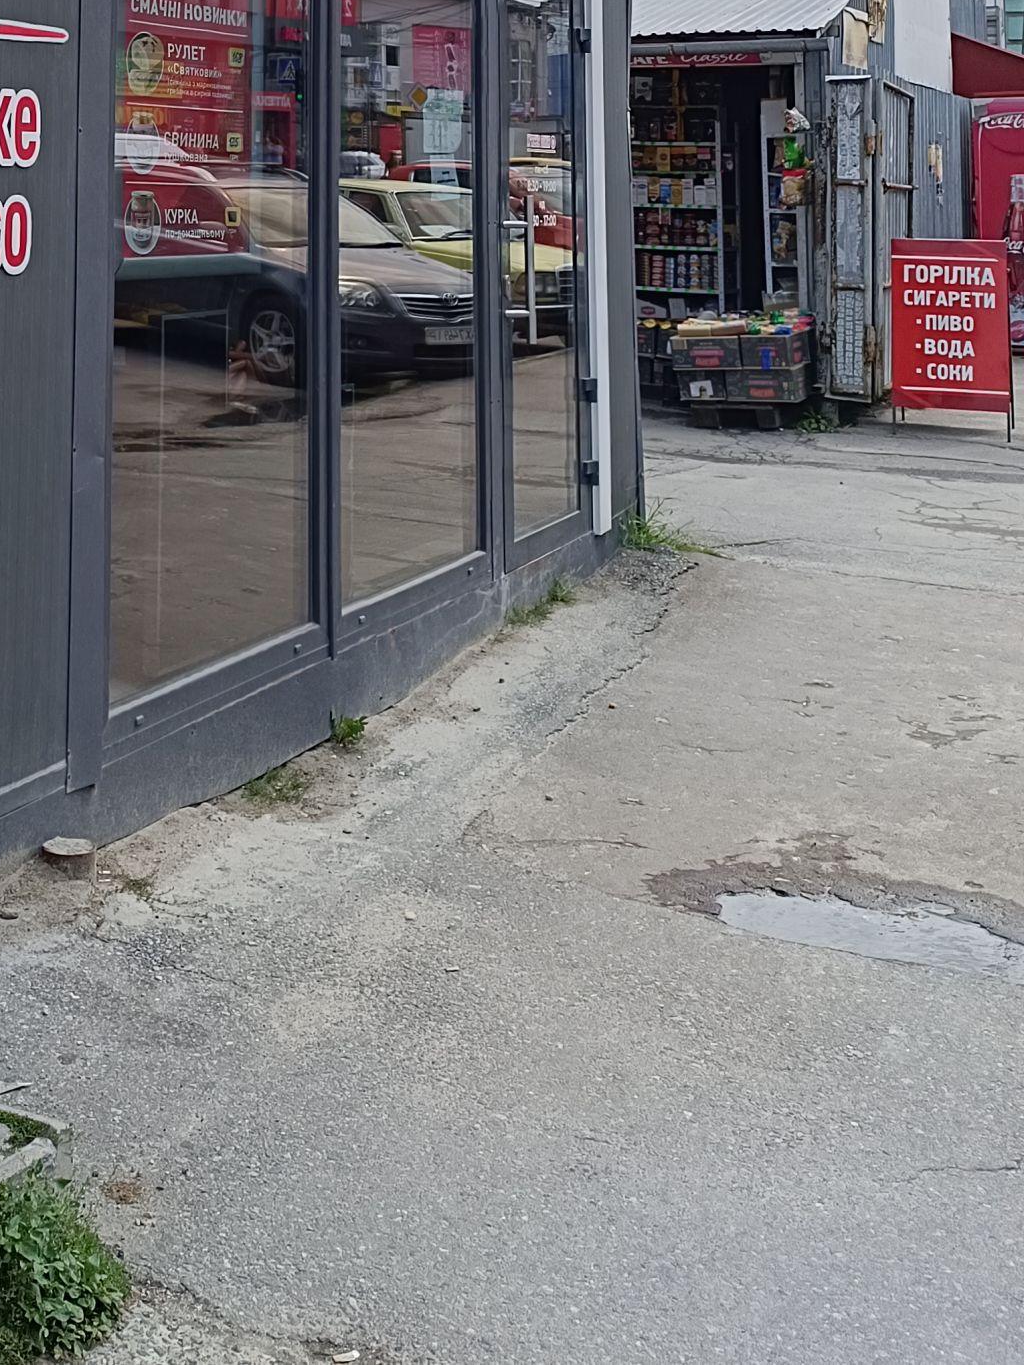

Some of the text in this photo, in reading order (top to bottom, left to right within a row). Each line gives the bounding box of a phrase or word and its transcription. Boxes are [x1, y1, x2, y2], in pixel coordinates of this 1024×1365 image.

[184, 3, 249, 28] НОВИНКИ
[167, 43, 206, 61] РУЛЕТ
[164, 132, 220, 150] СВИНИНА
[164, 208, 199, 224] КУРКА
[903, 264, 996, 286] ГОРІЛКА
[903, 289, 996, 309] СИГАРЕТИ
[925, 314, 974, 333] ПИВО
[924, 339, 975, 359] ВОДА
[926, 362, 974, 382] СОКИ
